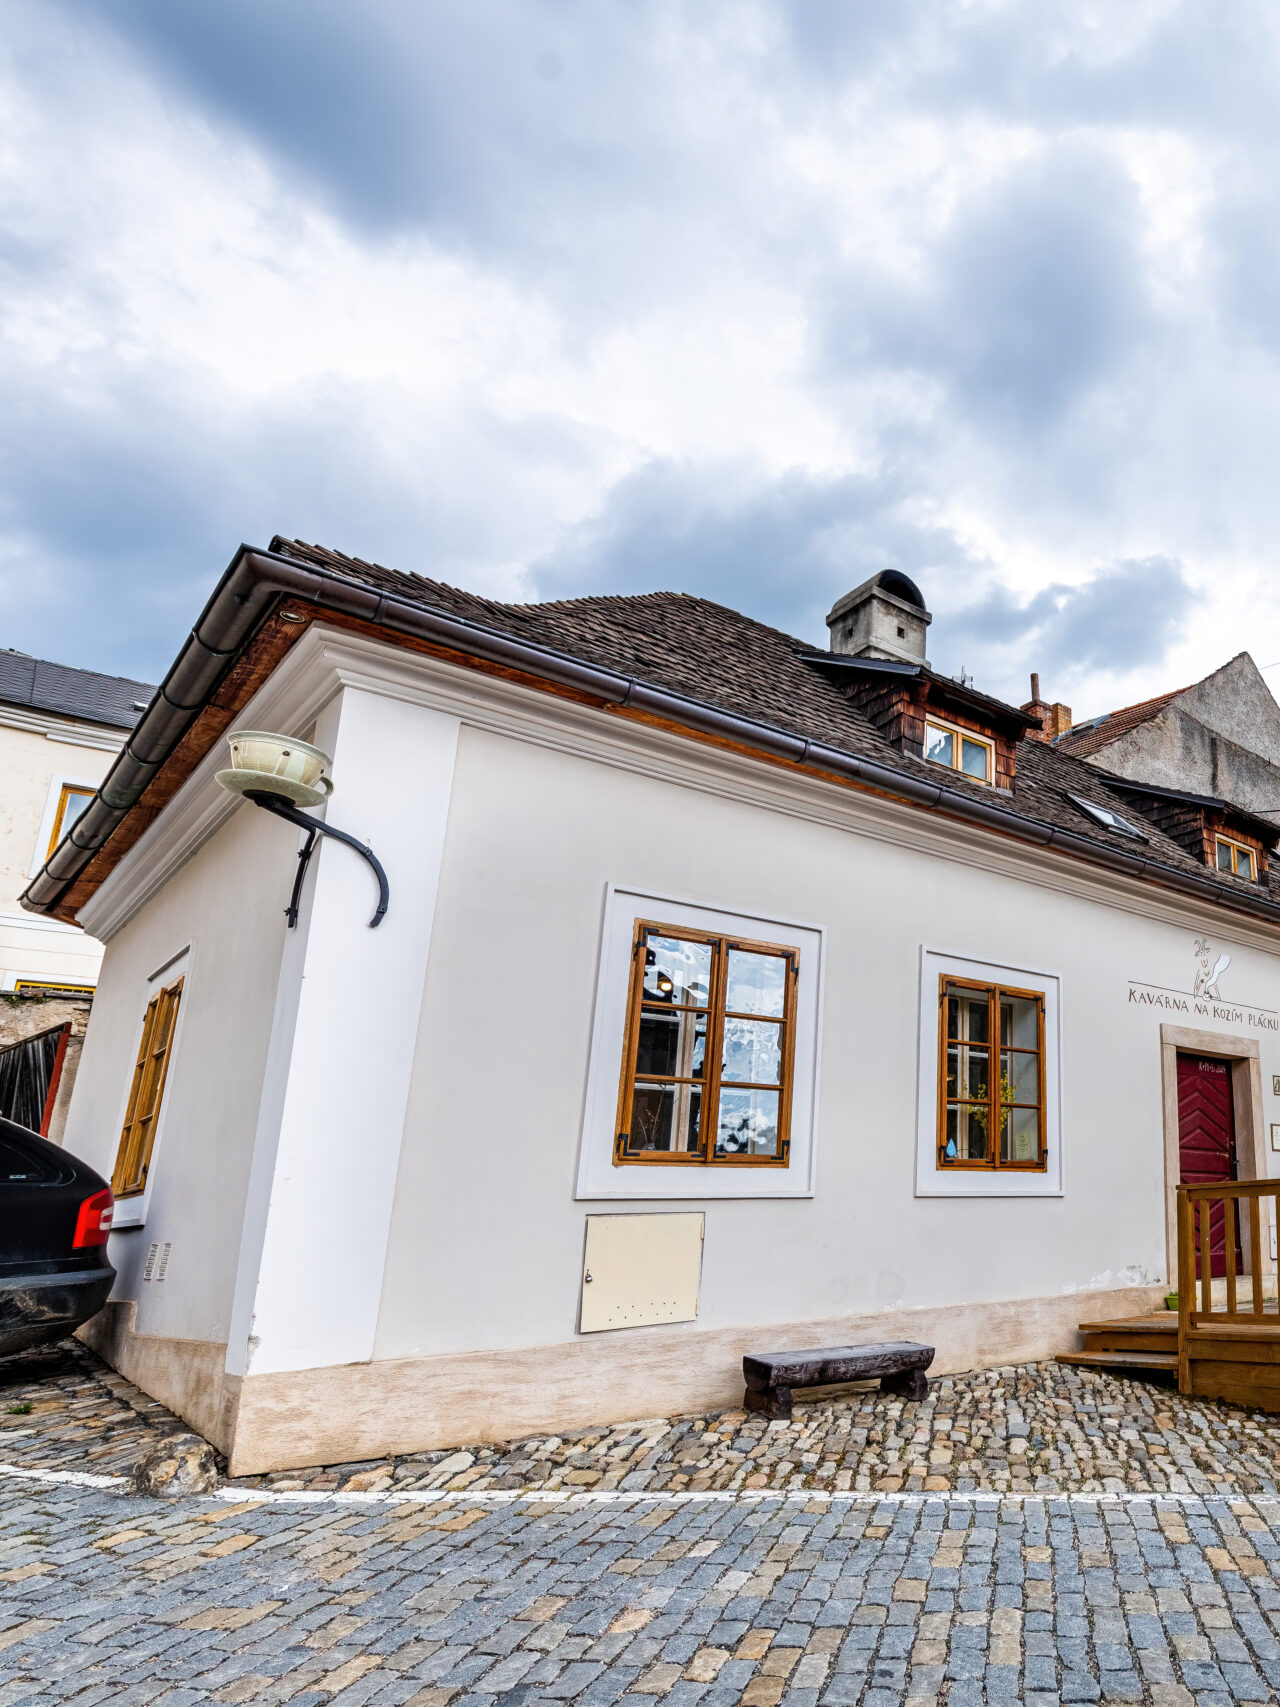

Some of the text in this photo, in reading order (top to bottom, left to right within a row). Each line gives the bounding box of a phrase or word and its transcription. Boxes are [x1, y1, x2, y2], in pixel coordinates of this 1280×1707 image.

[1128, 988, 1279, 1031] KAVÁRNA NA KOZÍM PLÁCKU
